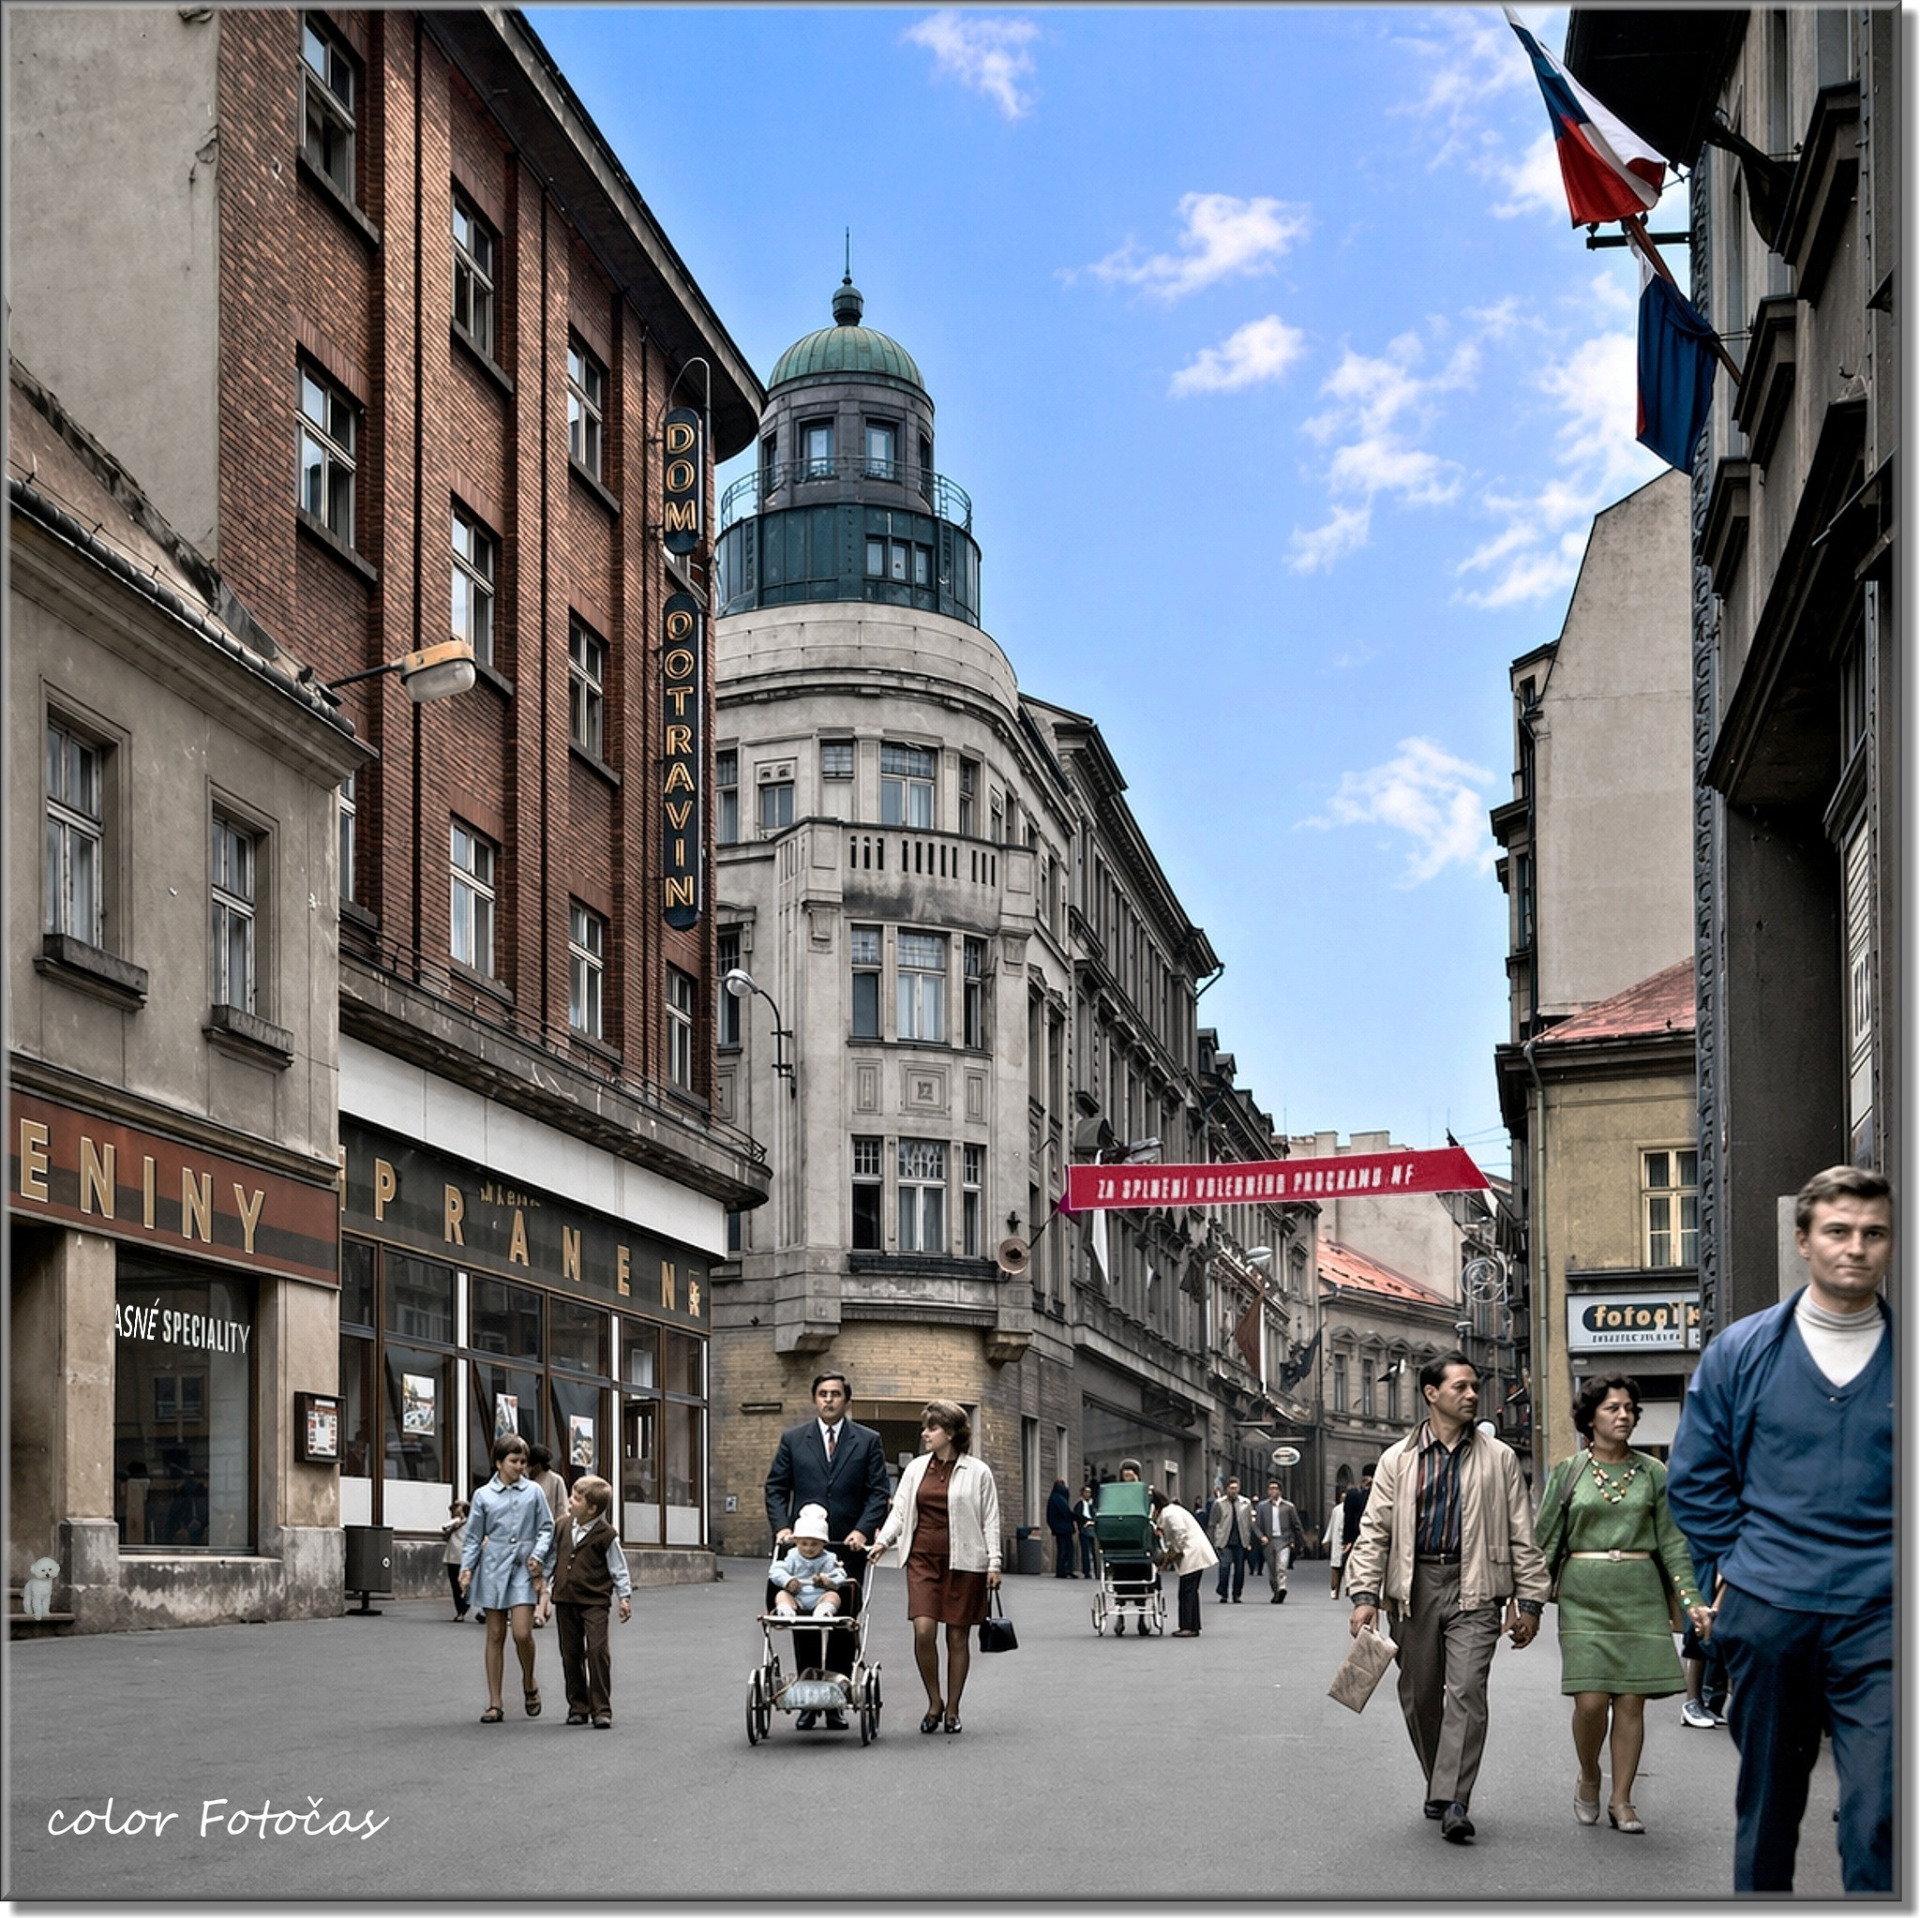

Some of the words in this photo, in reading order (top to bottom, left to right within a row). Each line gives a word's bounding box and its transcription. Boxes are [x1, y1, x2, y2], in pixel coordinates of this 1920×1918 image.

[665, 422, 697, 532] DOM
[20, 1117, 266, 1255] ENINY
[1097, 1178, 1115, 1199] ZA
[115, 1297, 160, 1341] ASNÉ
[161, 1308, 251, 1354] SPECIALITY
